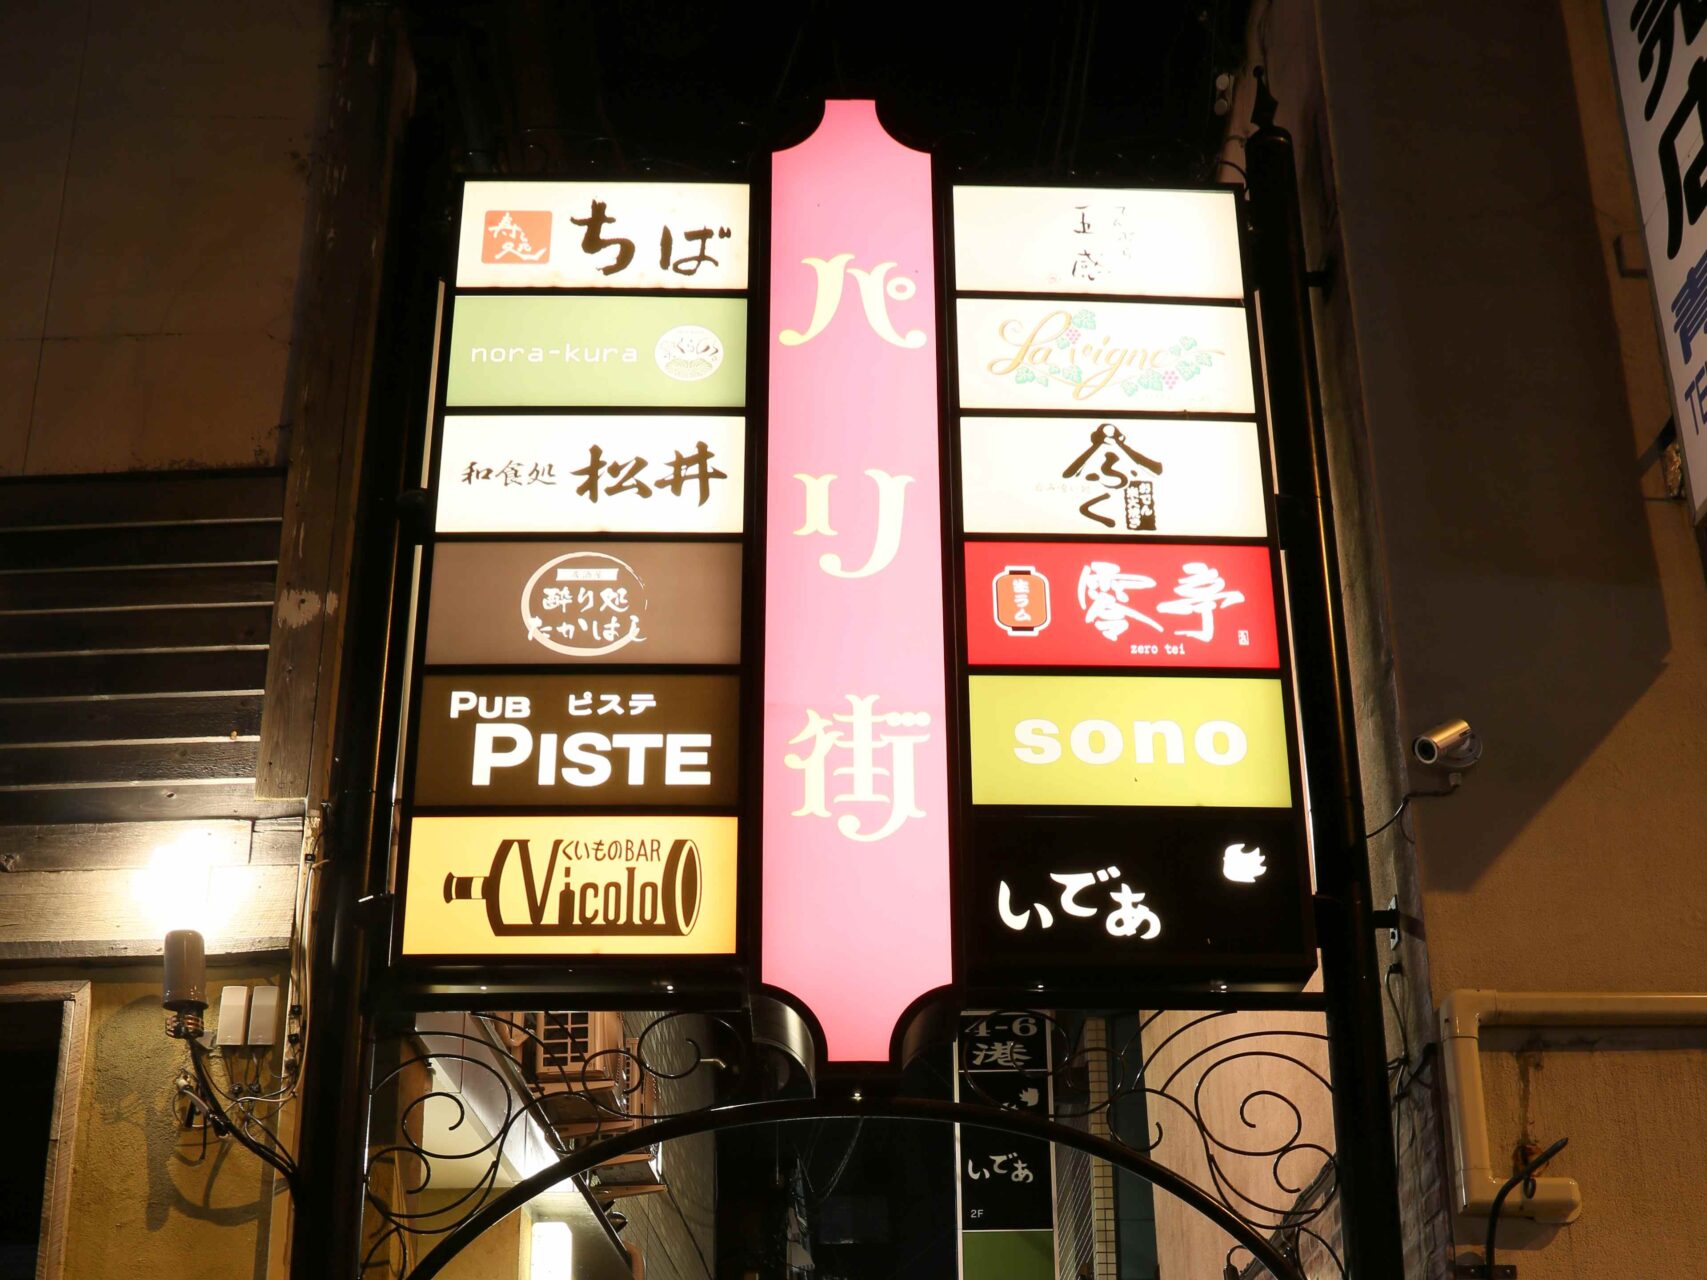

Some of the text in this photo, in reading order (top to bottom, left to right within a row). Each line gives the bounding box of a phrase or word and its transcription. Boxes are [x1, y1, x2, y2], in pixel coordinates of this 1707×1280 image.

[569, 198, 732, 276] ちば
[470, 342, 639, 364] nora-kura
[569, 440, 729, 508] 松井
[778, 251, 932, 843] パリ街
[1130, 643, 1186, 656] zero tei
[449, 690, 532, 719] PUB
[567, 691, 657, 717] ピステ
[470, 721, 712, 788] PISTE
[1013, 717, 1249, 767] sono
[970, 1208, 985, 1219] 2F
